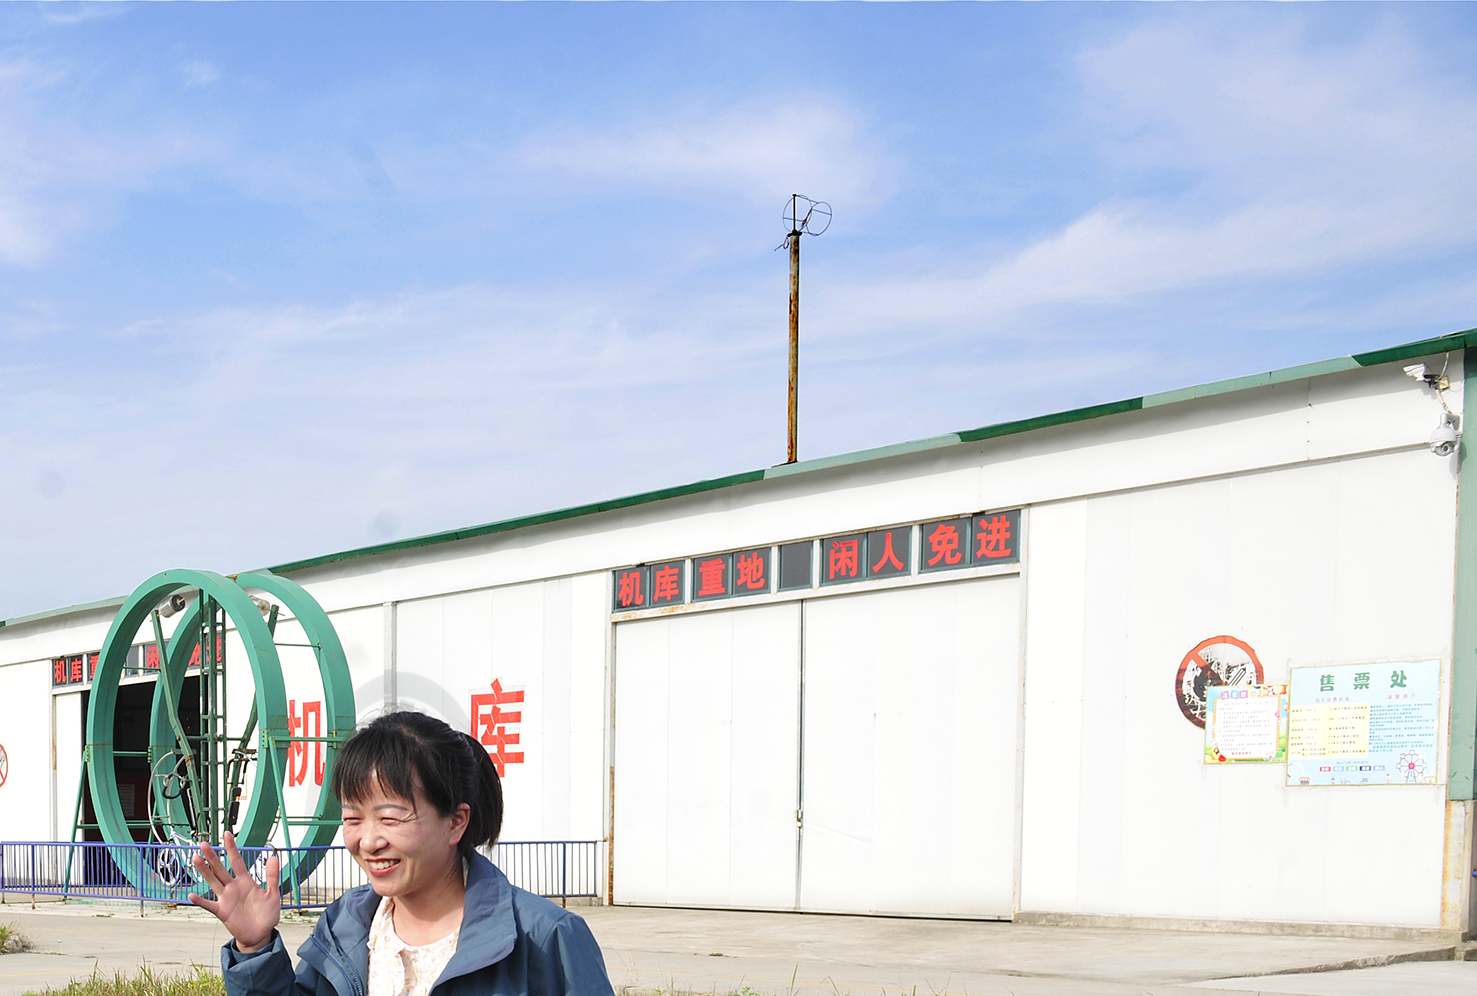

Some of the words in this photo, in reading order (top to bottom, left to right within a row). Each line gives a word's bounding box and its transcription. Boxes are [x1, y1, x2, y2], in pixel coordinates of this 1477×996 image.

[618, 552, 766, 607] 机库重地
[829, 515, 1012, 579] 闲人免进
[1319, 670, 1408, 692] 售票处
[287, 699, 326, 788] 机
[470, 678, 525, 778] 库
